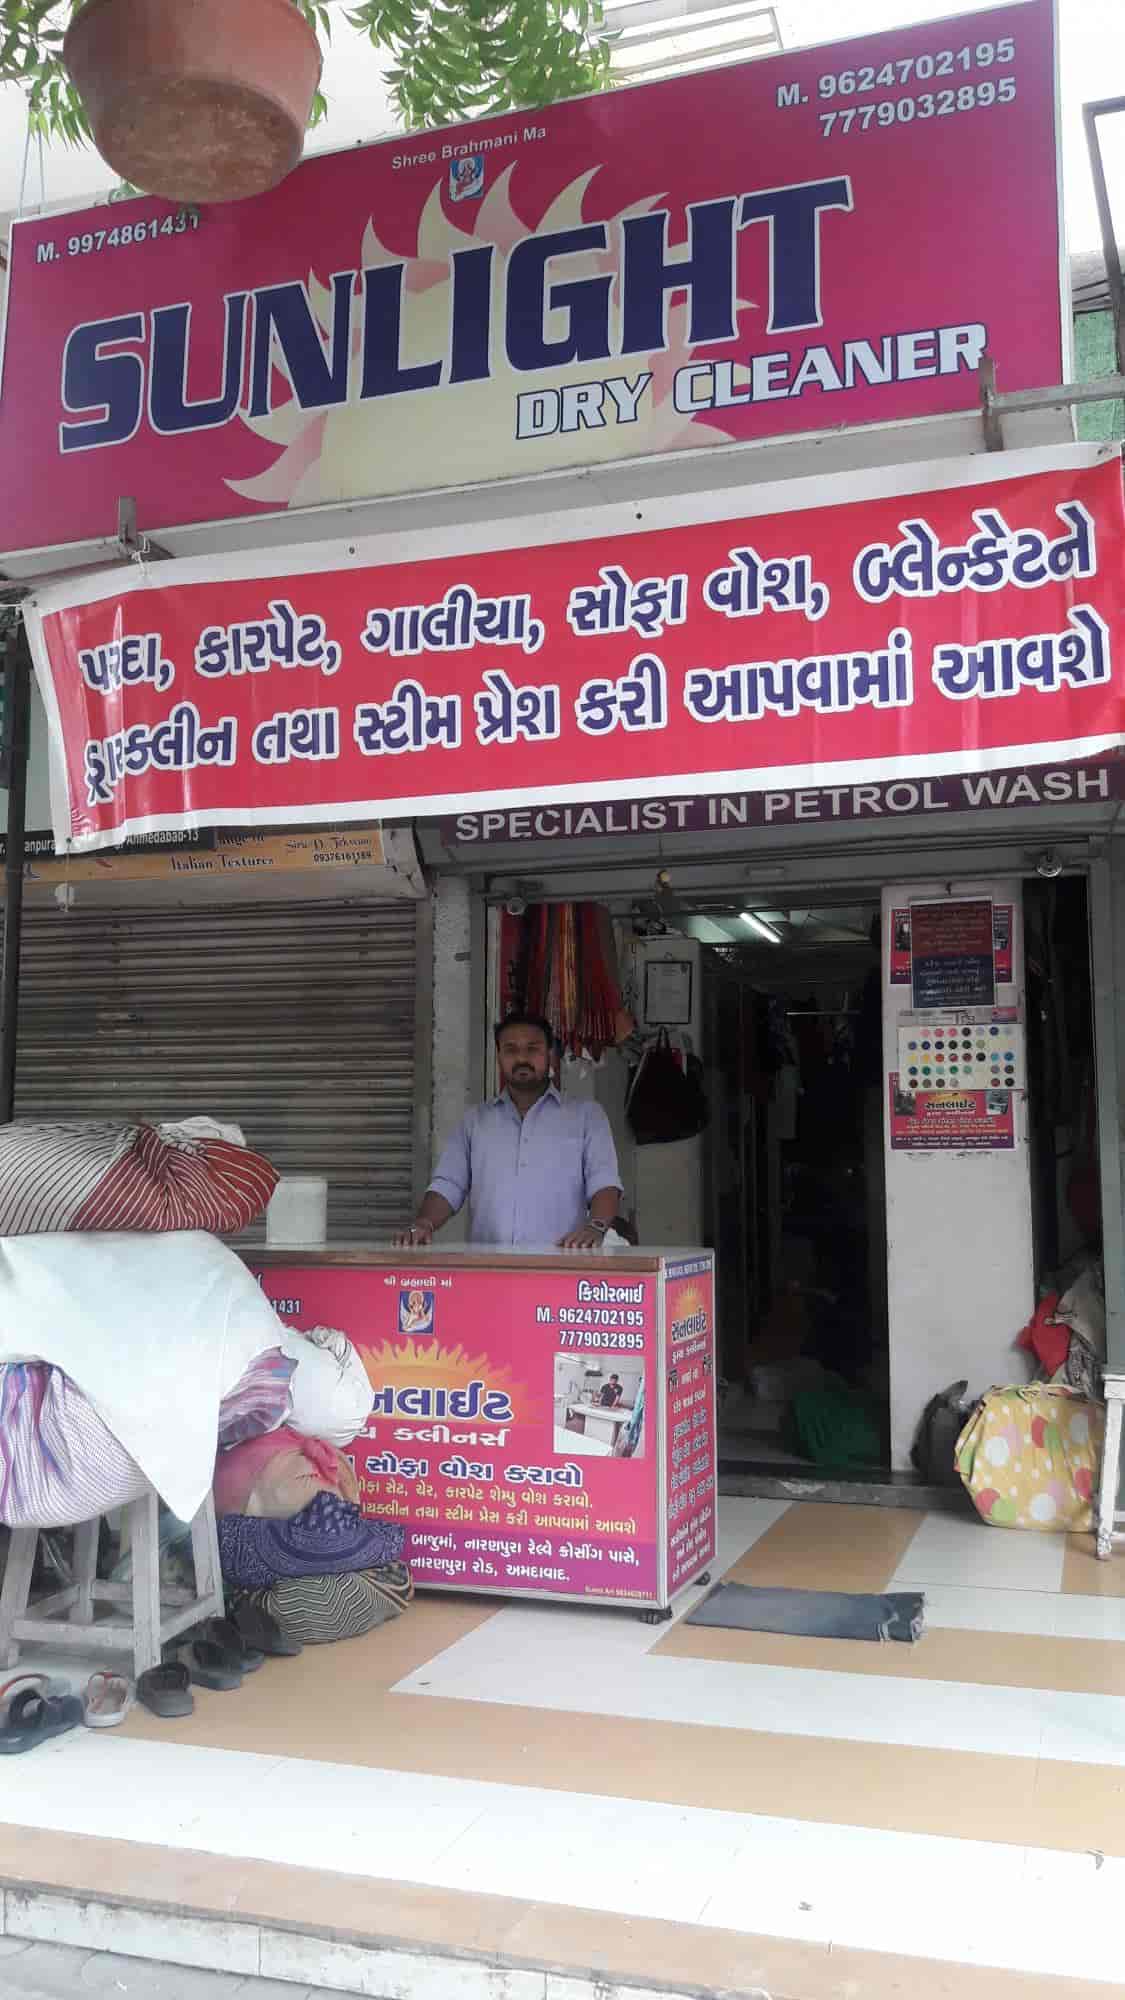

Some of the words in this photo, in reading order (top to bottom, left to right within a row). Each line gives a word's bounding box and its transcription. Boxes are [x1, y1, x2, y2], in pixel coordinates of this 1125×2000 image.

[776, 83, 809, 107] M.
[818, 37, 1016, 99] 9624702195
[818, 77, 1017, 137] 7779032895
[391, 150, 437, 169] Shree
[440, 130, 518, 159] Brahmani
[523, 126, 546, 143] Ma
[36, 242, 61, 263] M.
[67, 210, 201, 256] 9974861431
[59, 175, 853, 454] SUNLIGHT
[516, 372, 653, 440] DRY
[673, 322, 988, 414] CLEANER
[194, 599, 341, 676] કારપેટ,
[361, 583, 546, 653] ગાલીચા,
[567, 564, 688, 638] સોફા
[702, 545, 830, 620] વોશ,
[853, 500, 1097, 603] બ્લેન્કેટને
[251, 706, 340, 766] તથા
[353, 678, 462, 756] સ્ટીમ
[473, 668, 561, 745] પ્રેશ
[574, 652, 669, 736] કરી
[684, 626, 914, 724] આપવામાં
[932, 603, 1112, 700] આવશે
[455, 800, 694, 841] SPECIALIST
[708, 796, 747, 825] IN
[764, 781, 949, 821] PETROL
[962, 769, 1110, 806] WASH
[536, 1306, 555, 1323] M.
[558, 1306, 645, 1326] 9624702195
[558, 1330, 645, 1350] 7779032895
[371, 1381, 514, 1422] નલાઈટ
[366, 1451, 429, 1479] સોફા
[439, 1455, 494, 1481] વોશ
[503, 1462, 584, 1488] કરાવો
[446, 1483, 483, 1500] કારપેટ
[521, 1487, 547, 1505] વોશ
[415, 1504, 439, 1519] તથા
[445, 1503, 473, 1521] સ્ટીમ
[506, 1509, 528, 1526] કરી
[534, 1514, 589, 1531] આપવામાં
[595, 1517, 637, 1534] આવશે
[410, 1556, 466, 1576] નારણપુરા
[472, 1557, 498, 1577] રોડ,
[506, 1564, 570, 1581] અમદાવાદ.
[464, 1538, 521, 1557] નારણપુરા
[608, 1546, 640, 1567] પાસે,
